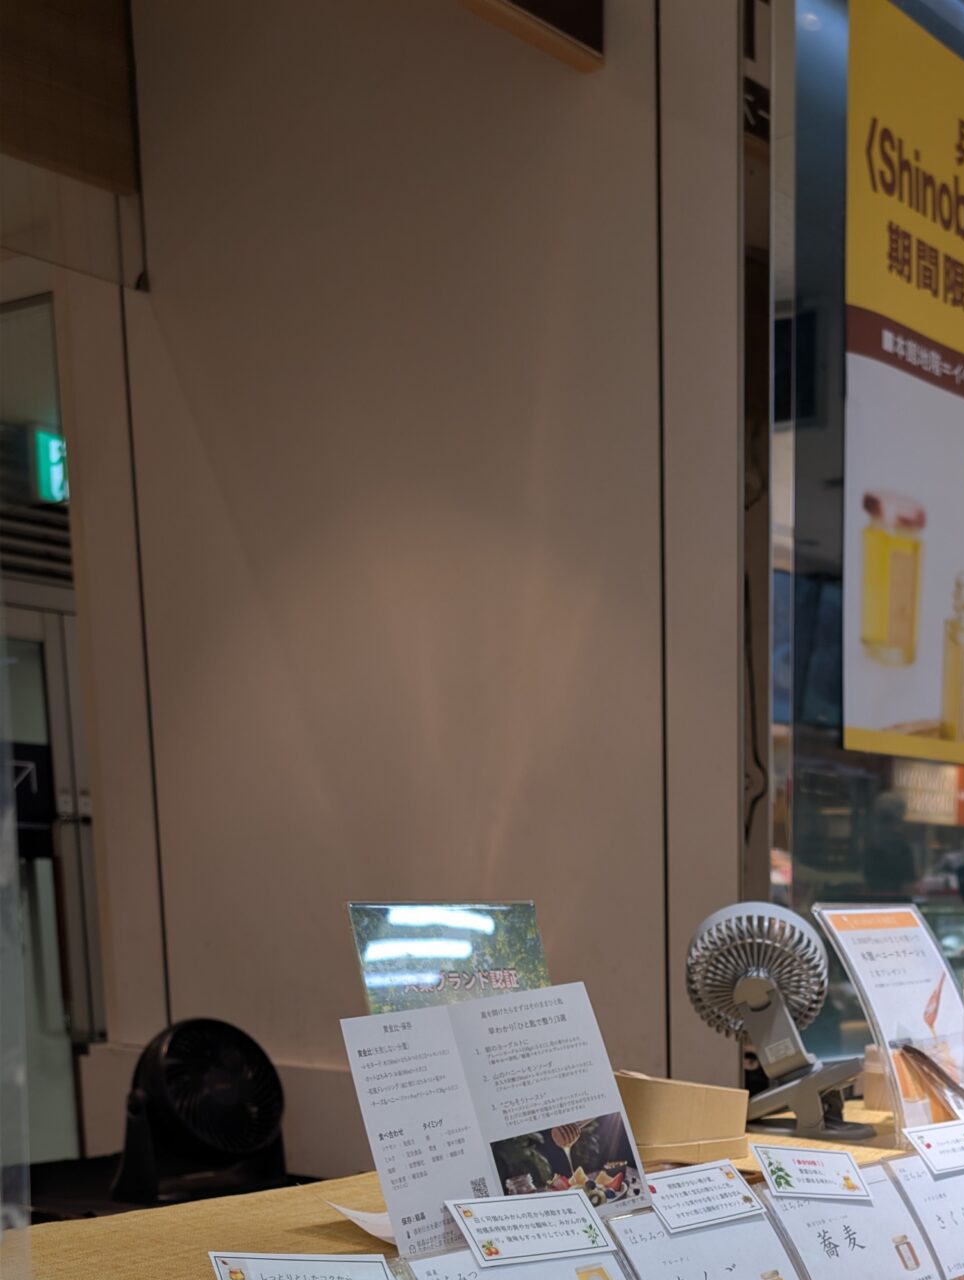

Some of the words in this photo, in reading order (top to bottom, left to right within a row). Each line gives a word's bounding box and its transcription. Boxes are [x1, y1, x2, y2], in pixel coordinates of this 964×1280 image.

[629, 1231, 664, 1244] はちみつ
[817, 1225, 866, 1258] 蕎麦
